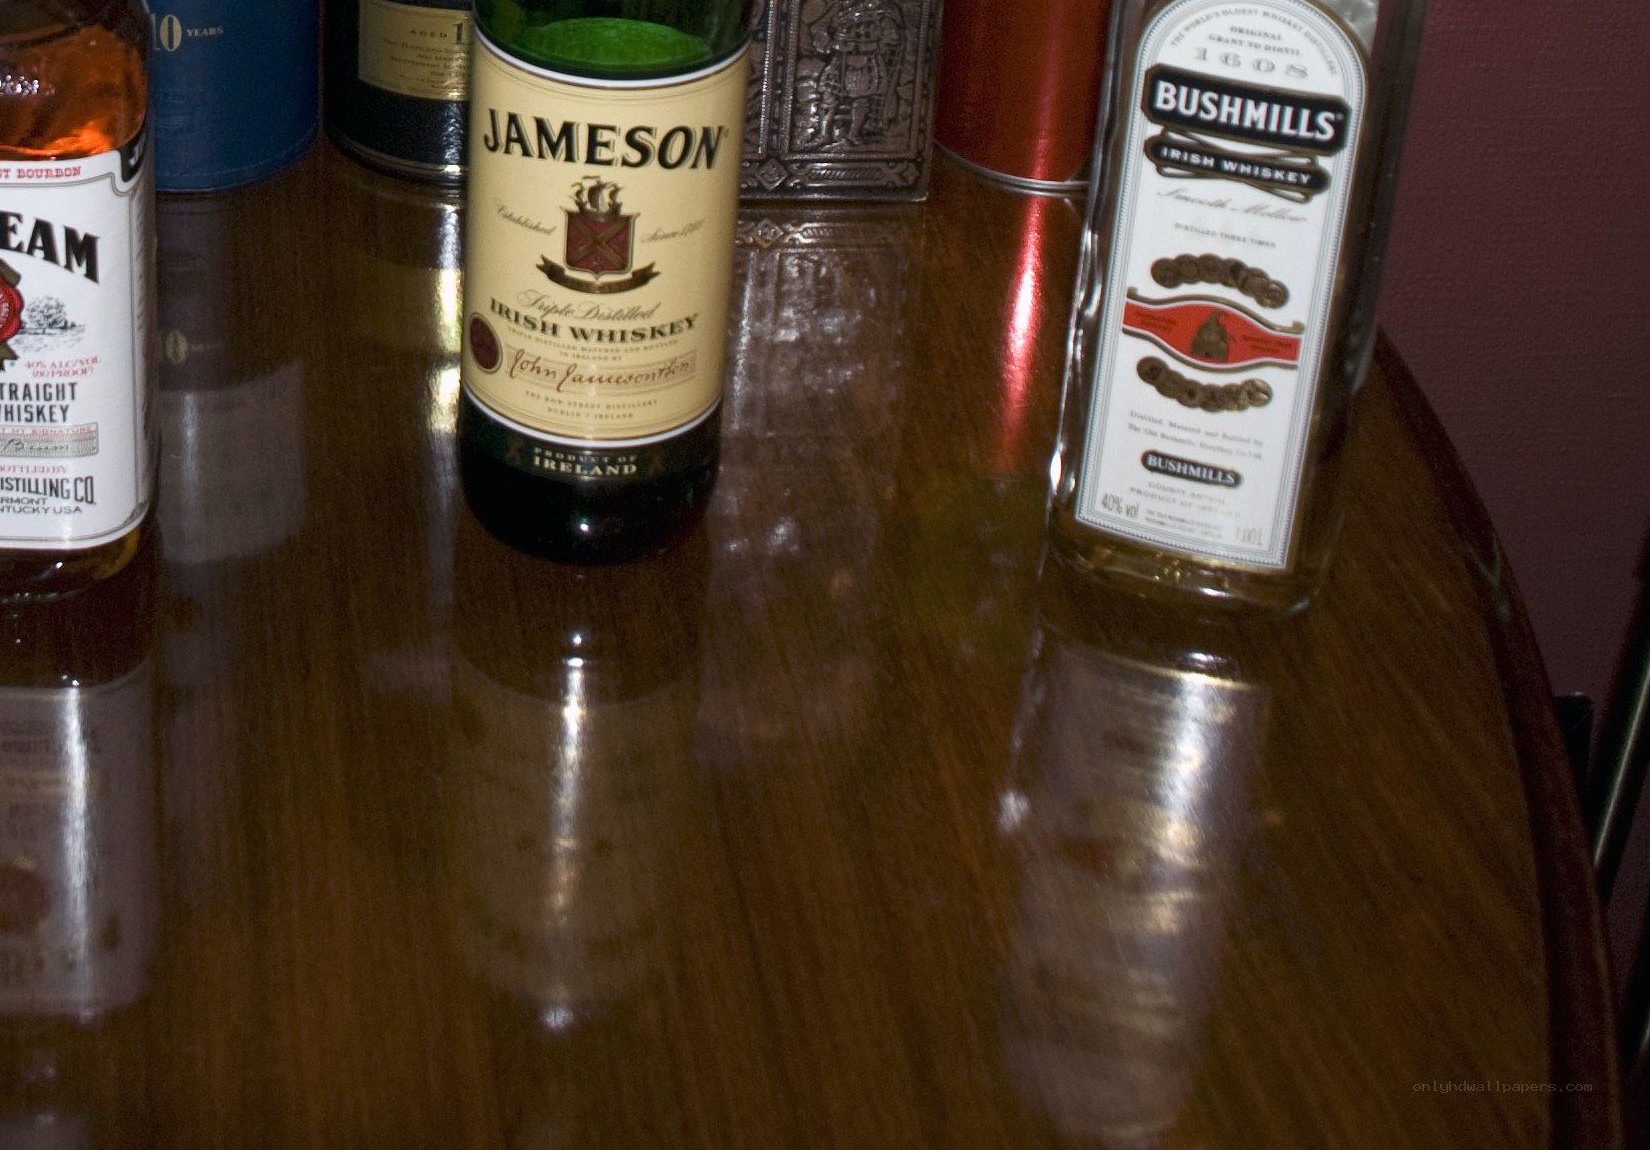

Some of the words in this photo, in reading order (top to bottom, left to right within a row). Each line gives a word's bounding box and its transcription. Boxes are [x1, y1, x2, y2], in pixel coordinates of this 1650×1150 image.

[186, 26, 224, 38] YEARS
[1194, 46, 1310, 79] 1608
[1154, 79, 1337, 142] BUSHMILLS
[482, 106, 726, 172] JAMESON
[15, 165, 82, 180] BOURBON
[1160, 146, 1216, 169] IRISH
[1220, 159, 1313, 185] WHISKEY
[489, 297, 563, 338] IRISH
[567, 312, 700, 345] WHISKEY
[517, 288, 577, 321] Triple
[573, 300, 663, 324] Distilled
[508, 347, 558, 381] John
[47, 464, 68, 475] BY
[532, 445, 611, 465] PRODUCT
[618, 452, 639, 464] OF
[532, 454, 640, 478] IRELAND
[1146, 453, 1236, 485] BUSHMILLS
[72, 474, 99, 506] CO.
[52, 505, 84, 515] USA
